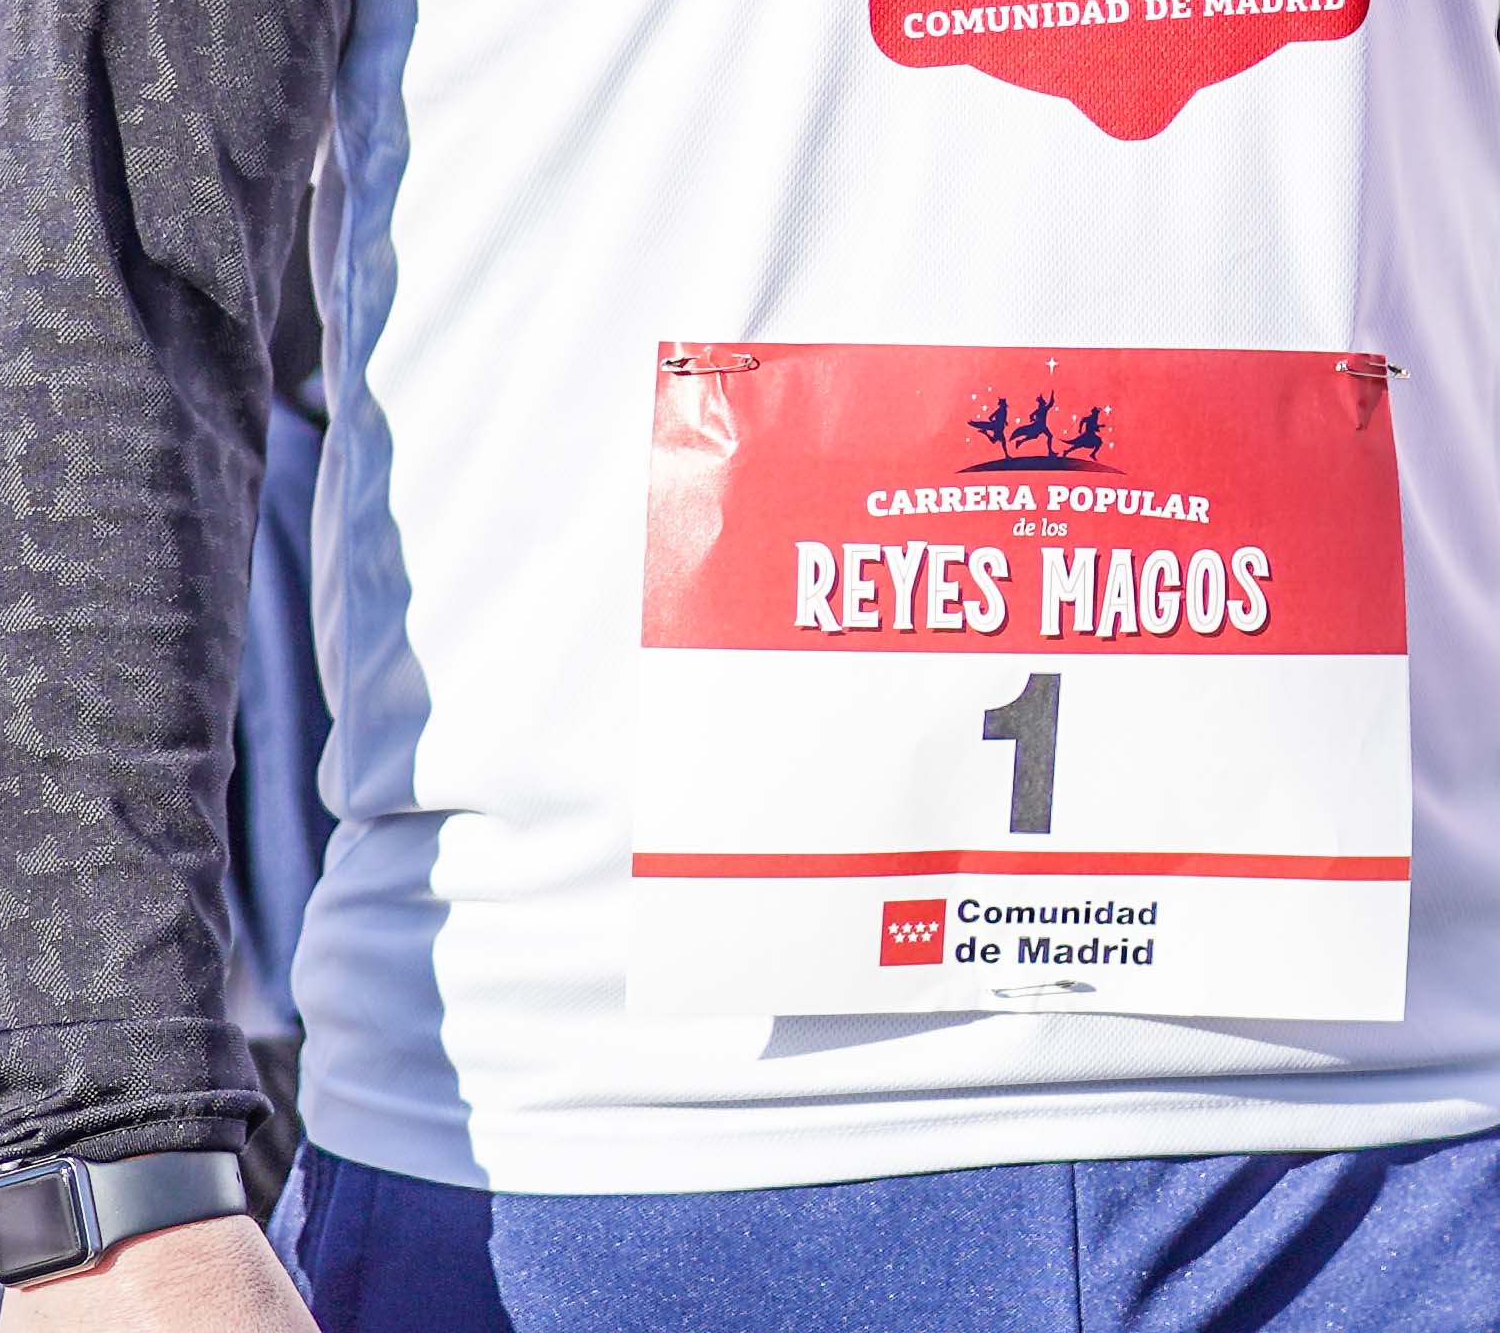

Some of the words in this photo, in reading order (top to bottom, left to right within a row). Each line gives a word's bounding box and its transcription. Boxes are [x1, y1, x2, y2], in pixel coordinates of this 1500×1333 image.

[867, 485, 1037, 519] CARRERA
[1047, 486, 1211, 523] POPULAR
[1013, 518, 1035, 537] de
[1040, 519, 1067, 537] los
[793, 541, 1010, 633] REYES
[1040, 545, 1271, 638] MAGOS
[982, 672, 1062, 835] 1
[956, 899, 1158, 927] Comunidad
[954, 938, 1002, 965] de
[1018, 937, 1155, 966] Madrid
